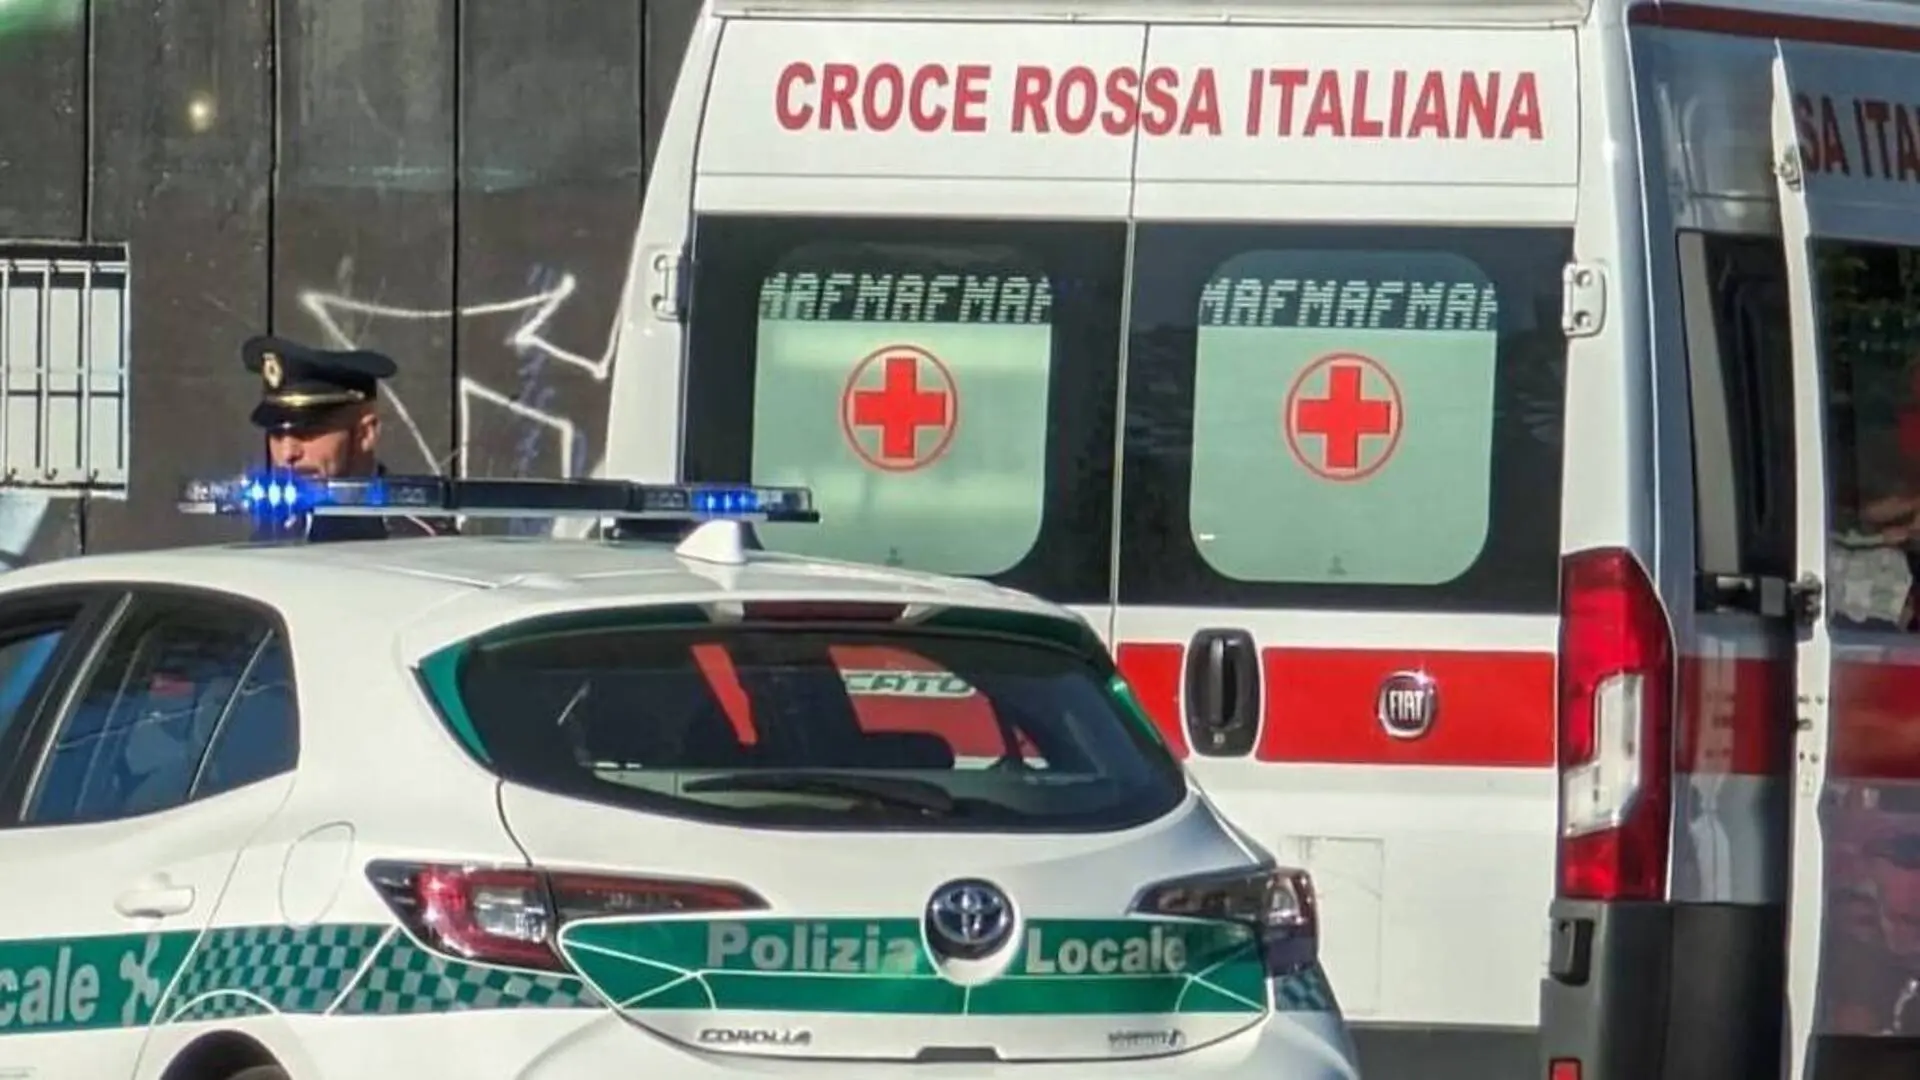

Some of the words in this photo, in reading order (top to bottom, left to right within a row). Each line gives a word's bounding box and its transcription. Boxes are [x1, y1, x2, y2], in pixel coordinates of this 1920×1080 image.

[775, 62, 991, 133] CROCE
[1011, 66, 1223, 137] ROSSA
[1244, 69, 1545, 141] ITALIANA
[1795, 92, 1851, 176] SA
[1852, 97, 1920, 182] ITA
[1389, 690, 1425, 721] FIAT
[706, 920, 919, 975] Polizia
[1026, 925, 1187, 974] Locale
